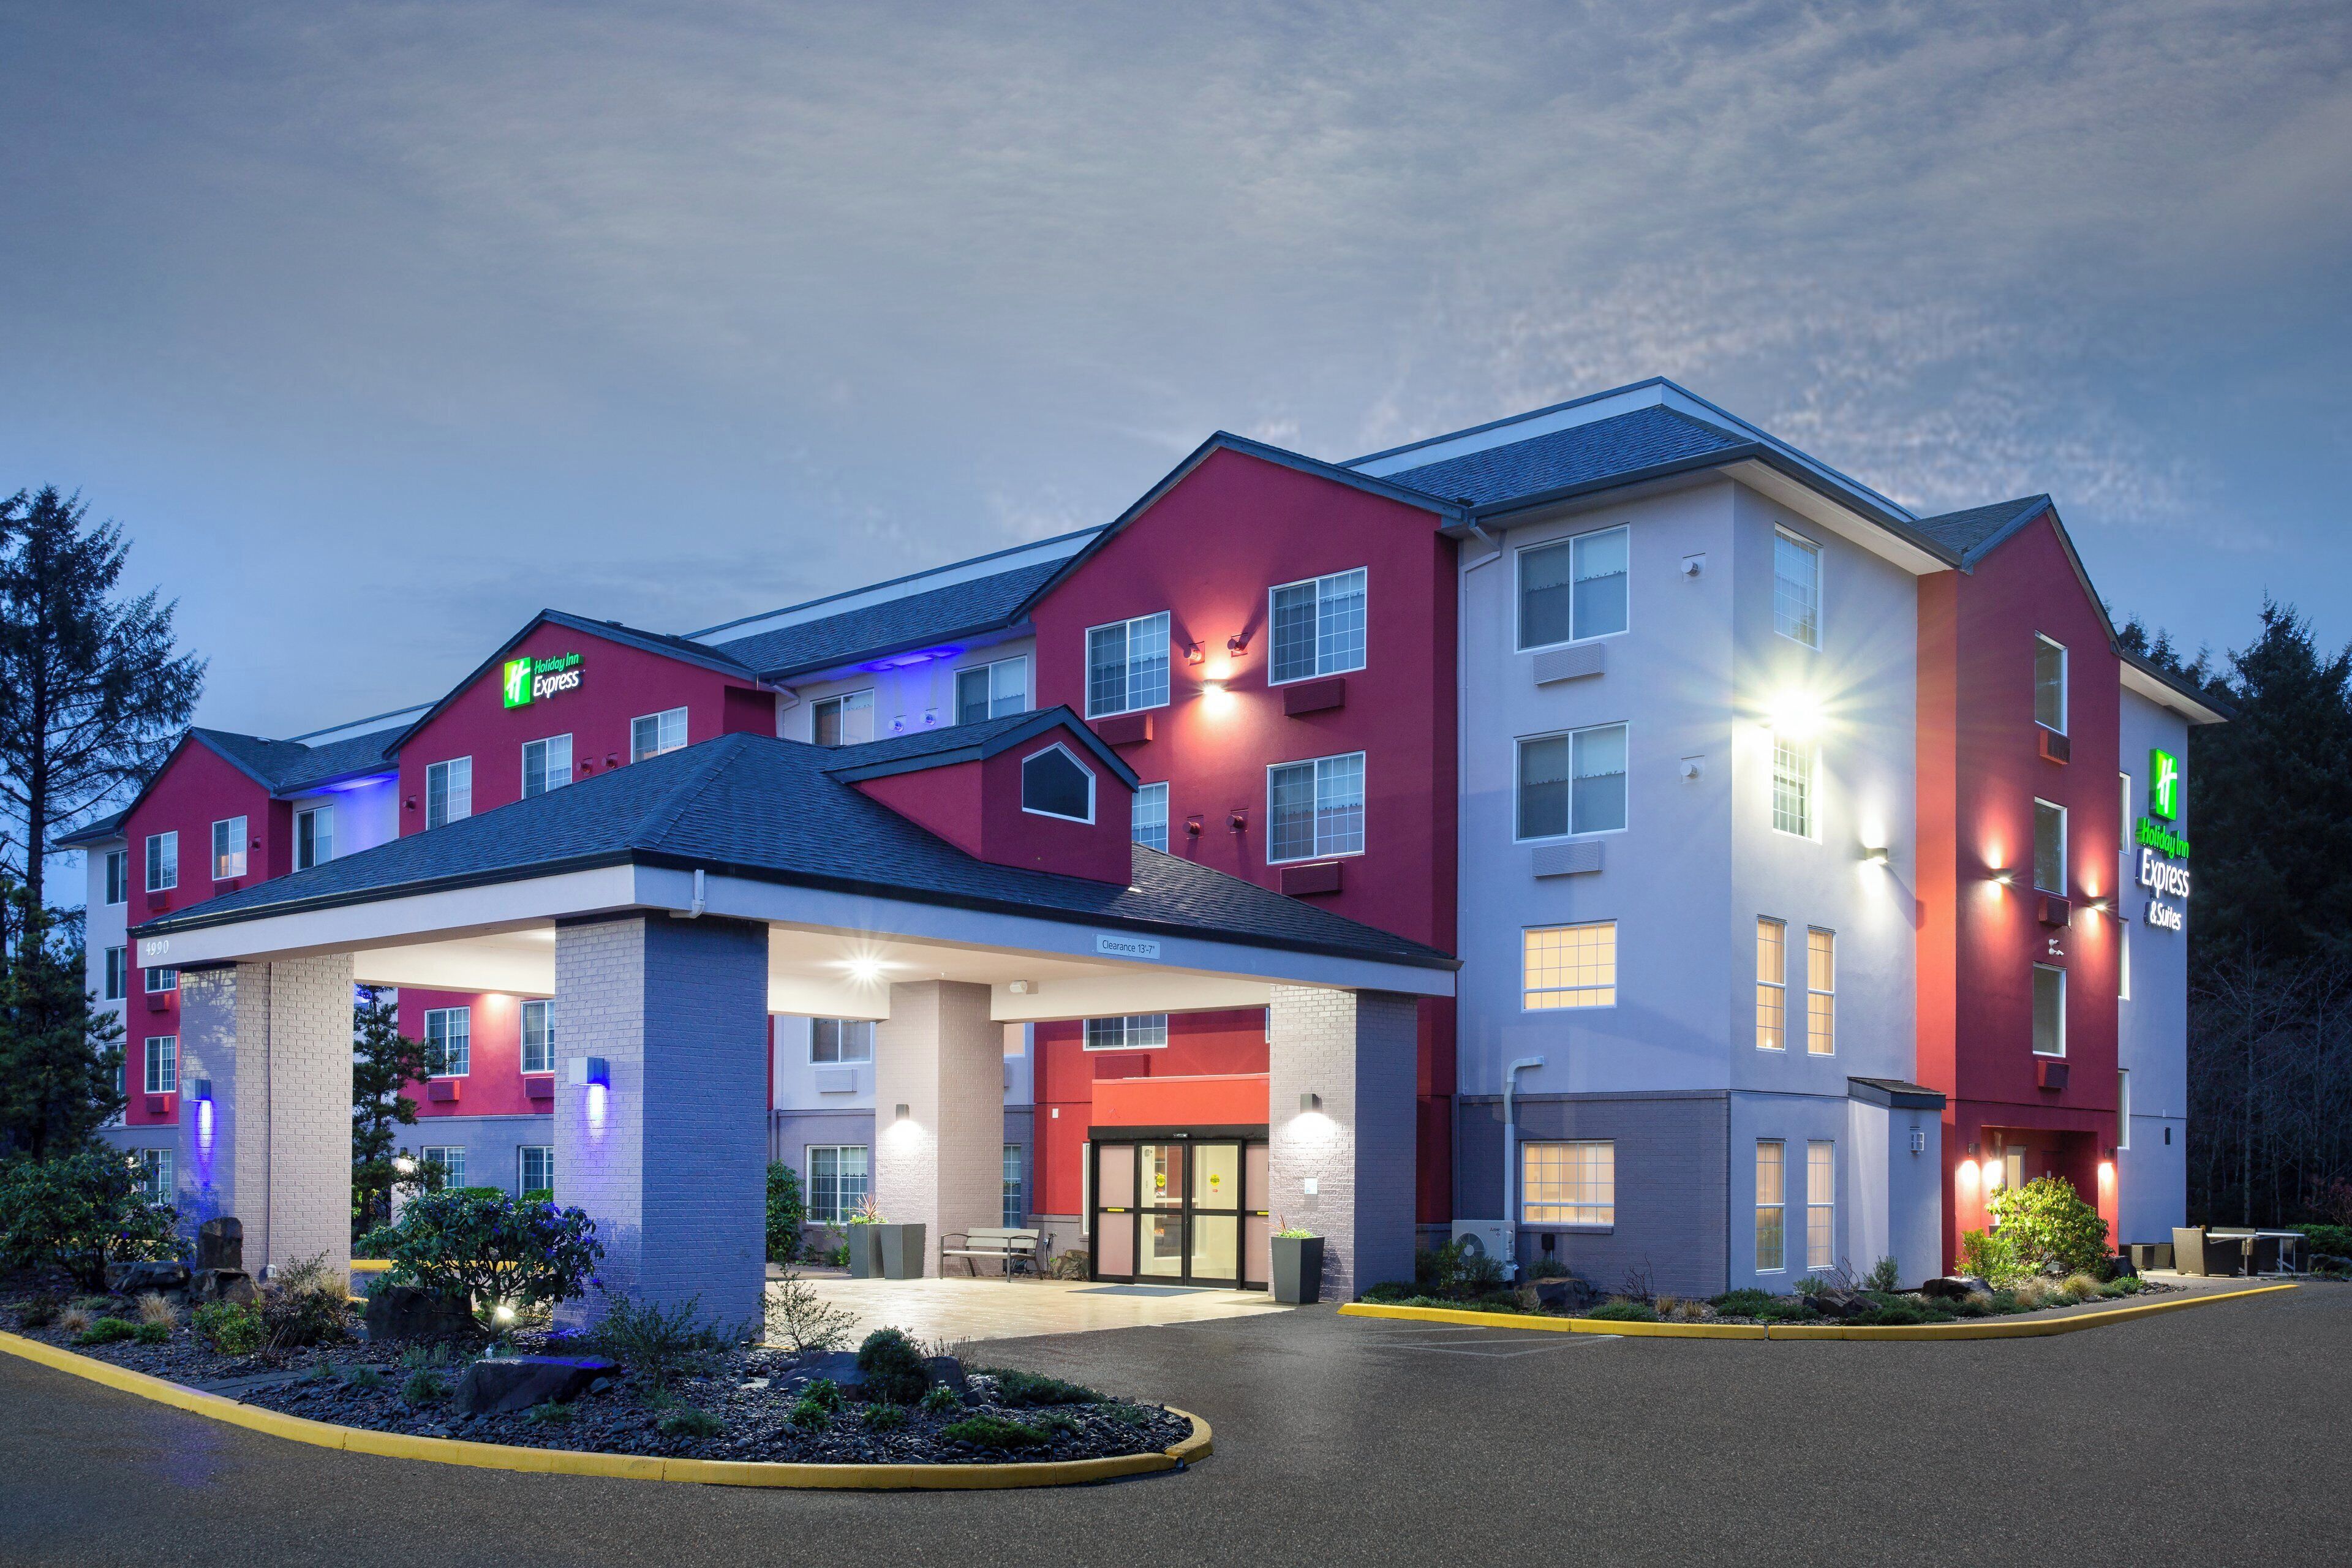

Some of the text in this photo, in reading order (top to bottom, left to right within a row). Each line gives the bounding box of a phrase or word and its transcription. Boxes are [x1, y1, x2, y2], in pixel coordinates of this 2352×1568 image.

[533, 652, 579, 674] Holiday Inn
[533, 670, 579, 699] Express
[2142, 817, 2190, 859] Holiday Inn
[2141, 848, 2190, 899] Express
[145, 940, 169, 956] 4990
[1102, 940, 1155, 954] Clearance 13'-7"
